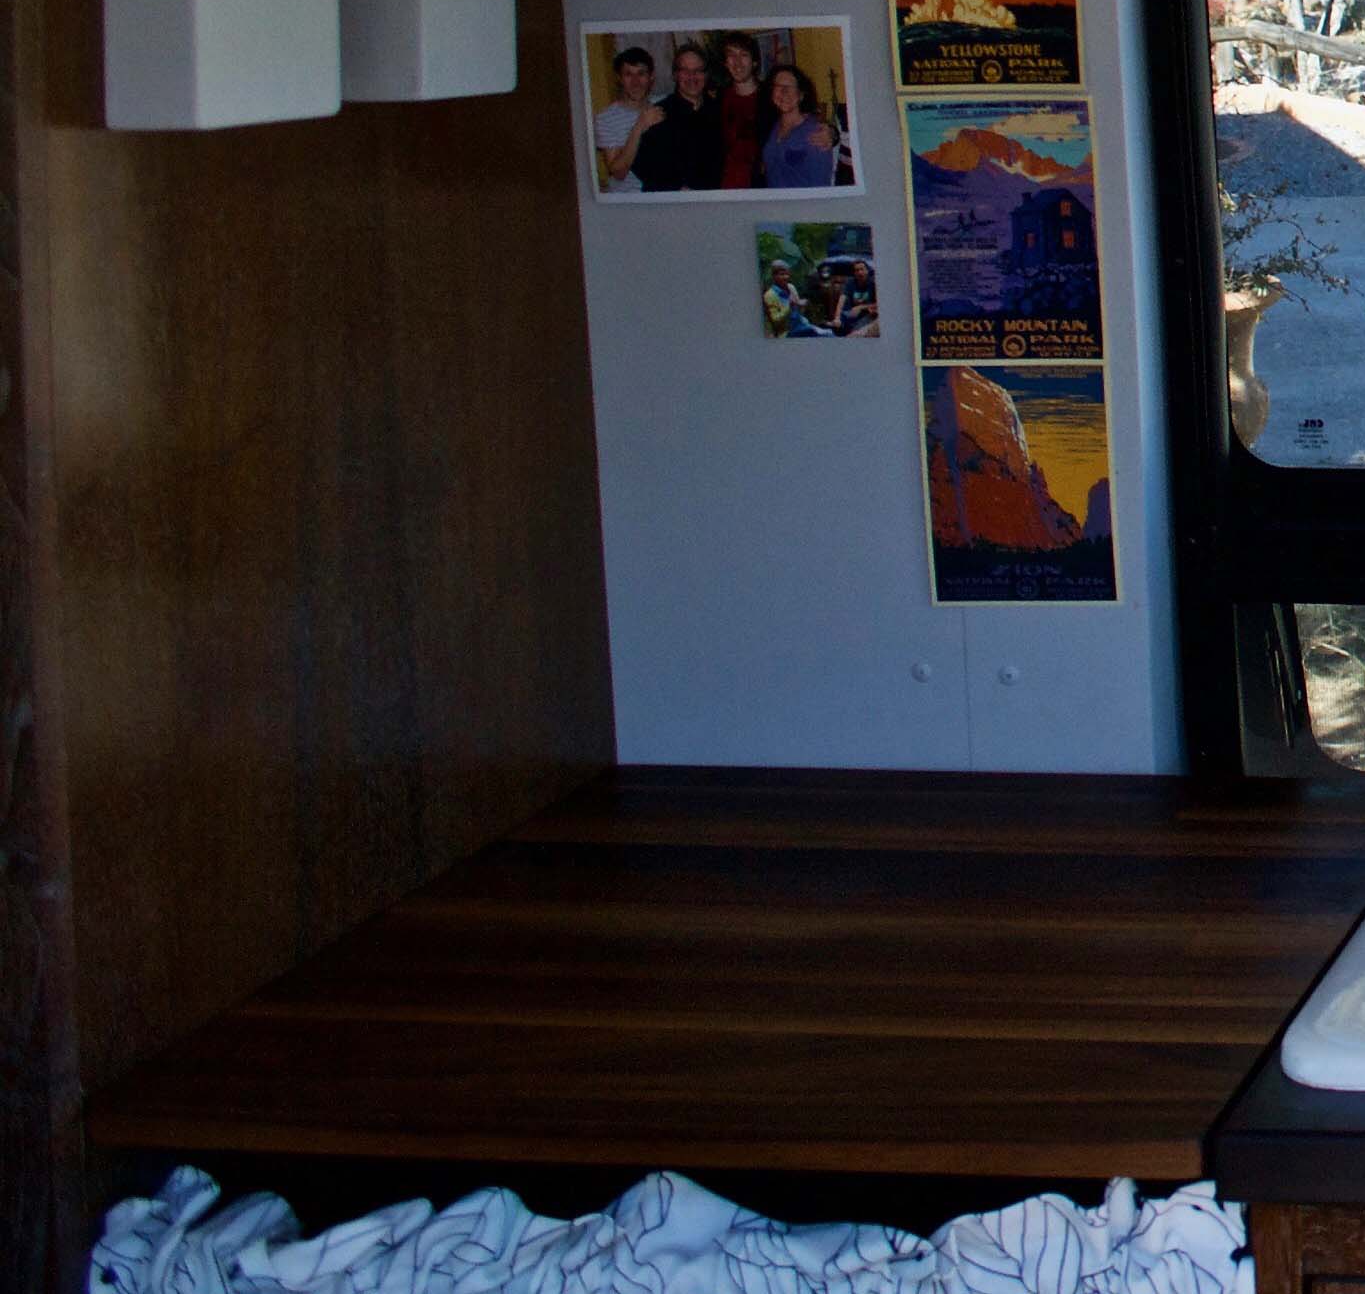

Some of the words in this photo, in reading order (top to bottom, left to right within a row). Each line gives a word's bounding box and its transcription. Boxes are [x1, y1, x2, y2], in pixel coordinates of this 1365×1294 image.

[939, 43, 1041, 58] YELLOWSTONE
[912, 58, 977, 69] NATIONAL
[1008, 57, 1063, 68] PARK
[936, 319, 995, 332] ROCKY
[1003, 319, 1089, 332] MOUNTAIN
[930, 335, 996, 345] NATIONAL
[1030, 333, 1095, 344] PARK
[991, 564, 1062, 576] ZION
